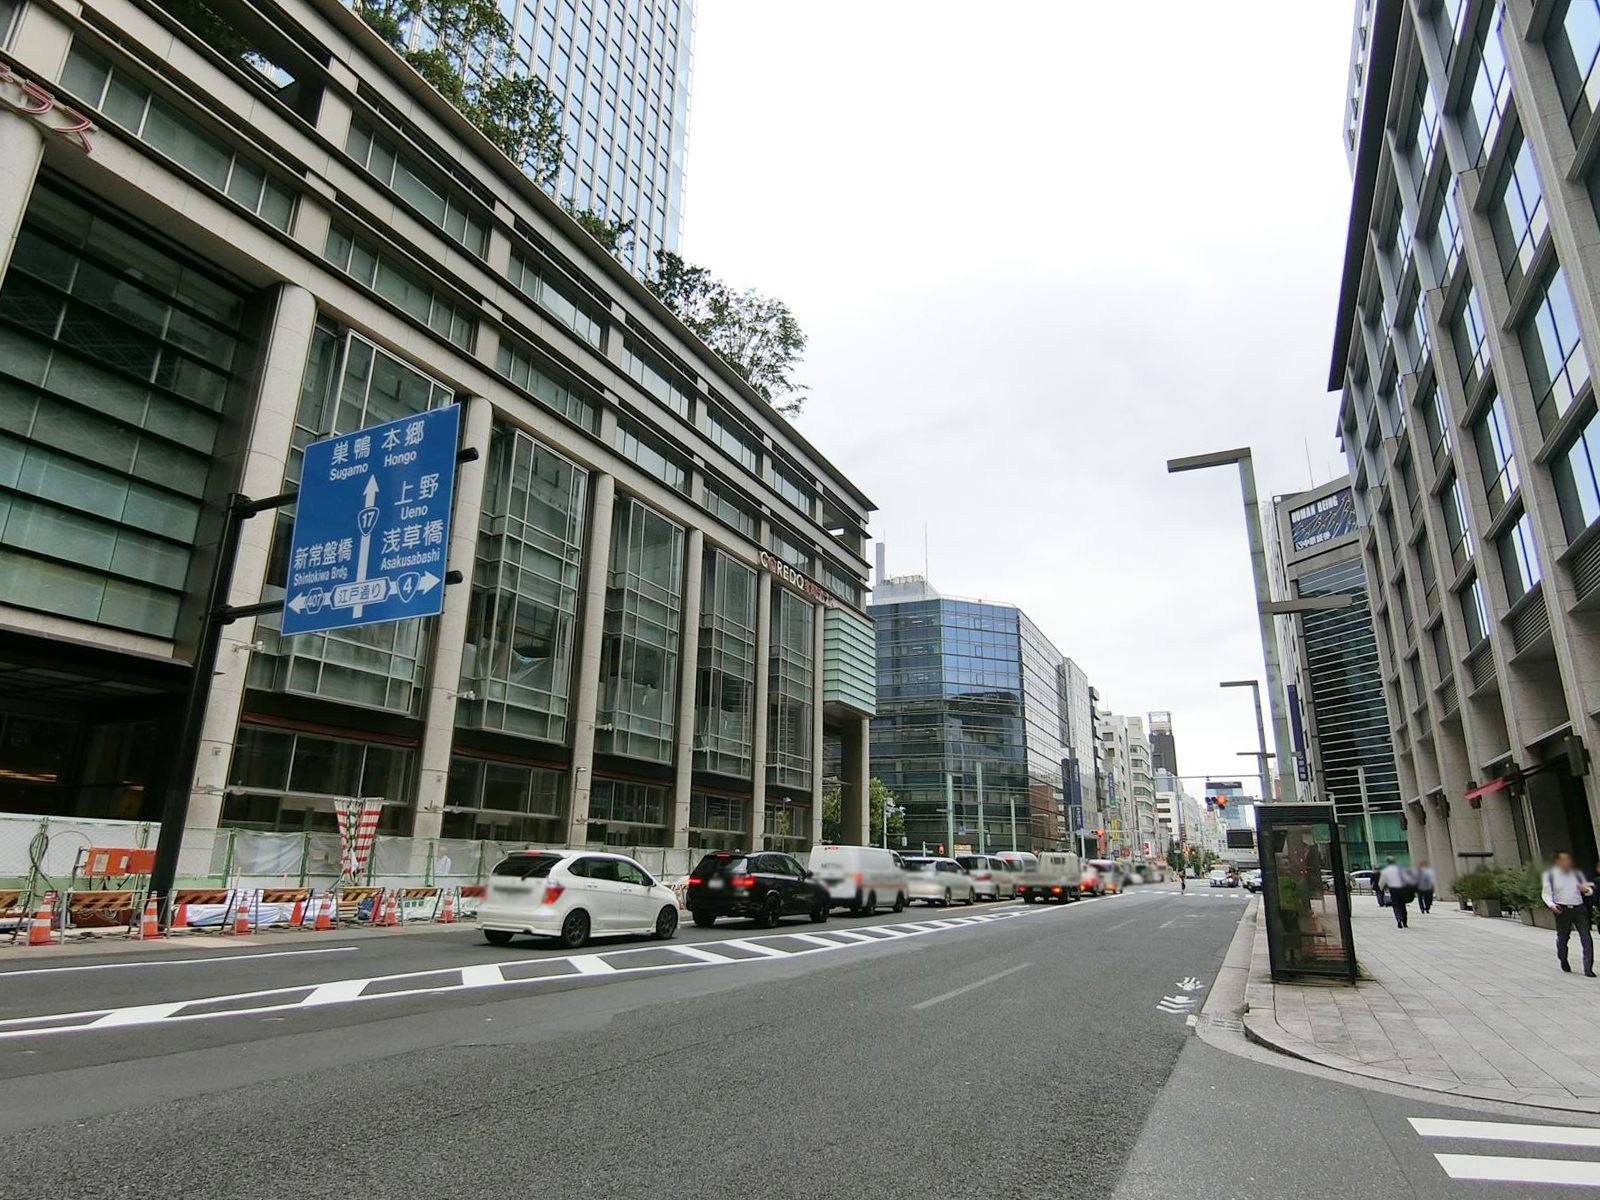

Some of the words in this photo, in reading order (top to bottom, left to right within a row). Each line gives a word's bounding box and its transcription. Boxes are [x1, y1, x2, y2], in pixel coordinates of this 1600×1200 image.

[331, 435, 371, 466] 巣鴨
[381, 420, 425, 451] 本郷
[329, 462, 368, 482] Sugamo
[384, 449, 417, 468] Hongo
[394, 473, 439, 506] 上野
[361, 511, 375, 529] 17
[401, 504, 428, 521] Ueno
[1291, 504, 1316, 524] HUMAN
[1317, 495, 1338, 513] BEING
[381, 519, 444, 555] 浅草橋
[293, 537, 353, 570] 新常盤橋
[380, 547, 440, 571] Asakusabashi
[293, 569, 330, 587] Shintokiwa
[760, 551, 805, 591] COREDO
[338, 583, 381, 604] 江戸通り
[403, 576, 412, 594] 4
[308, 593, 323, 607] 407
